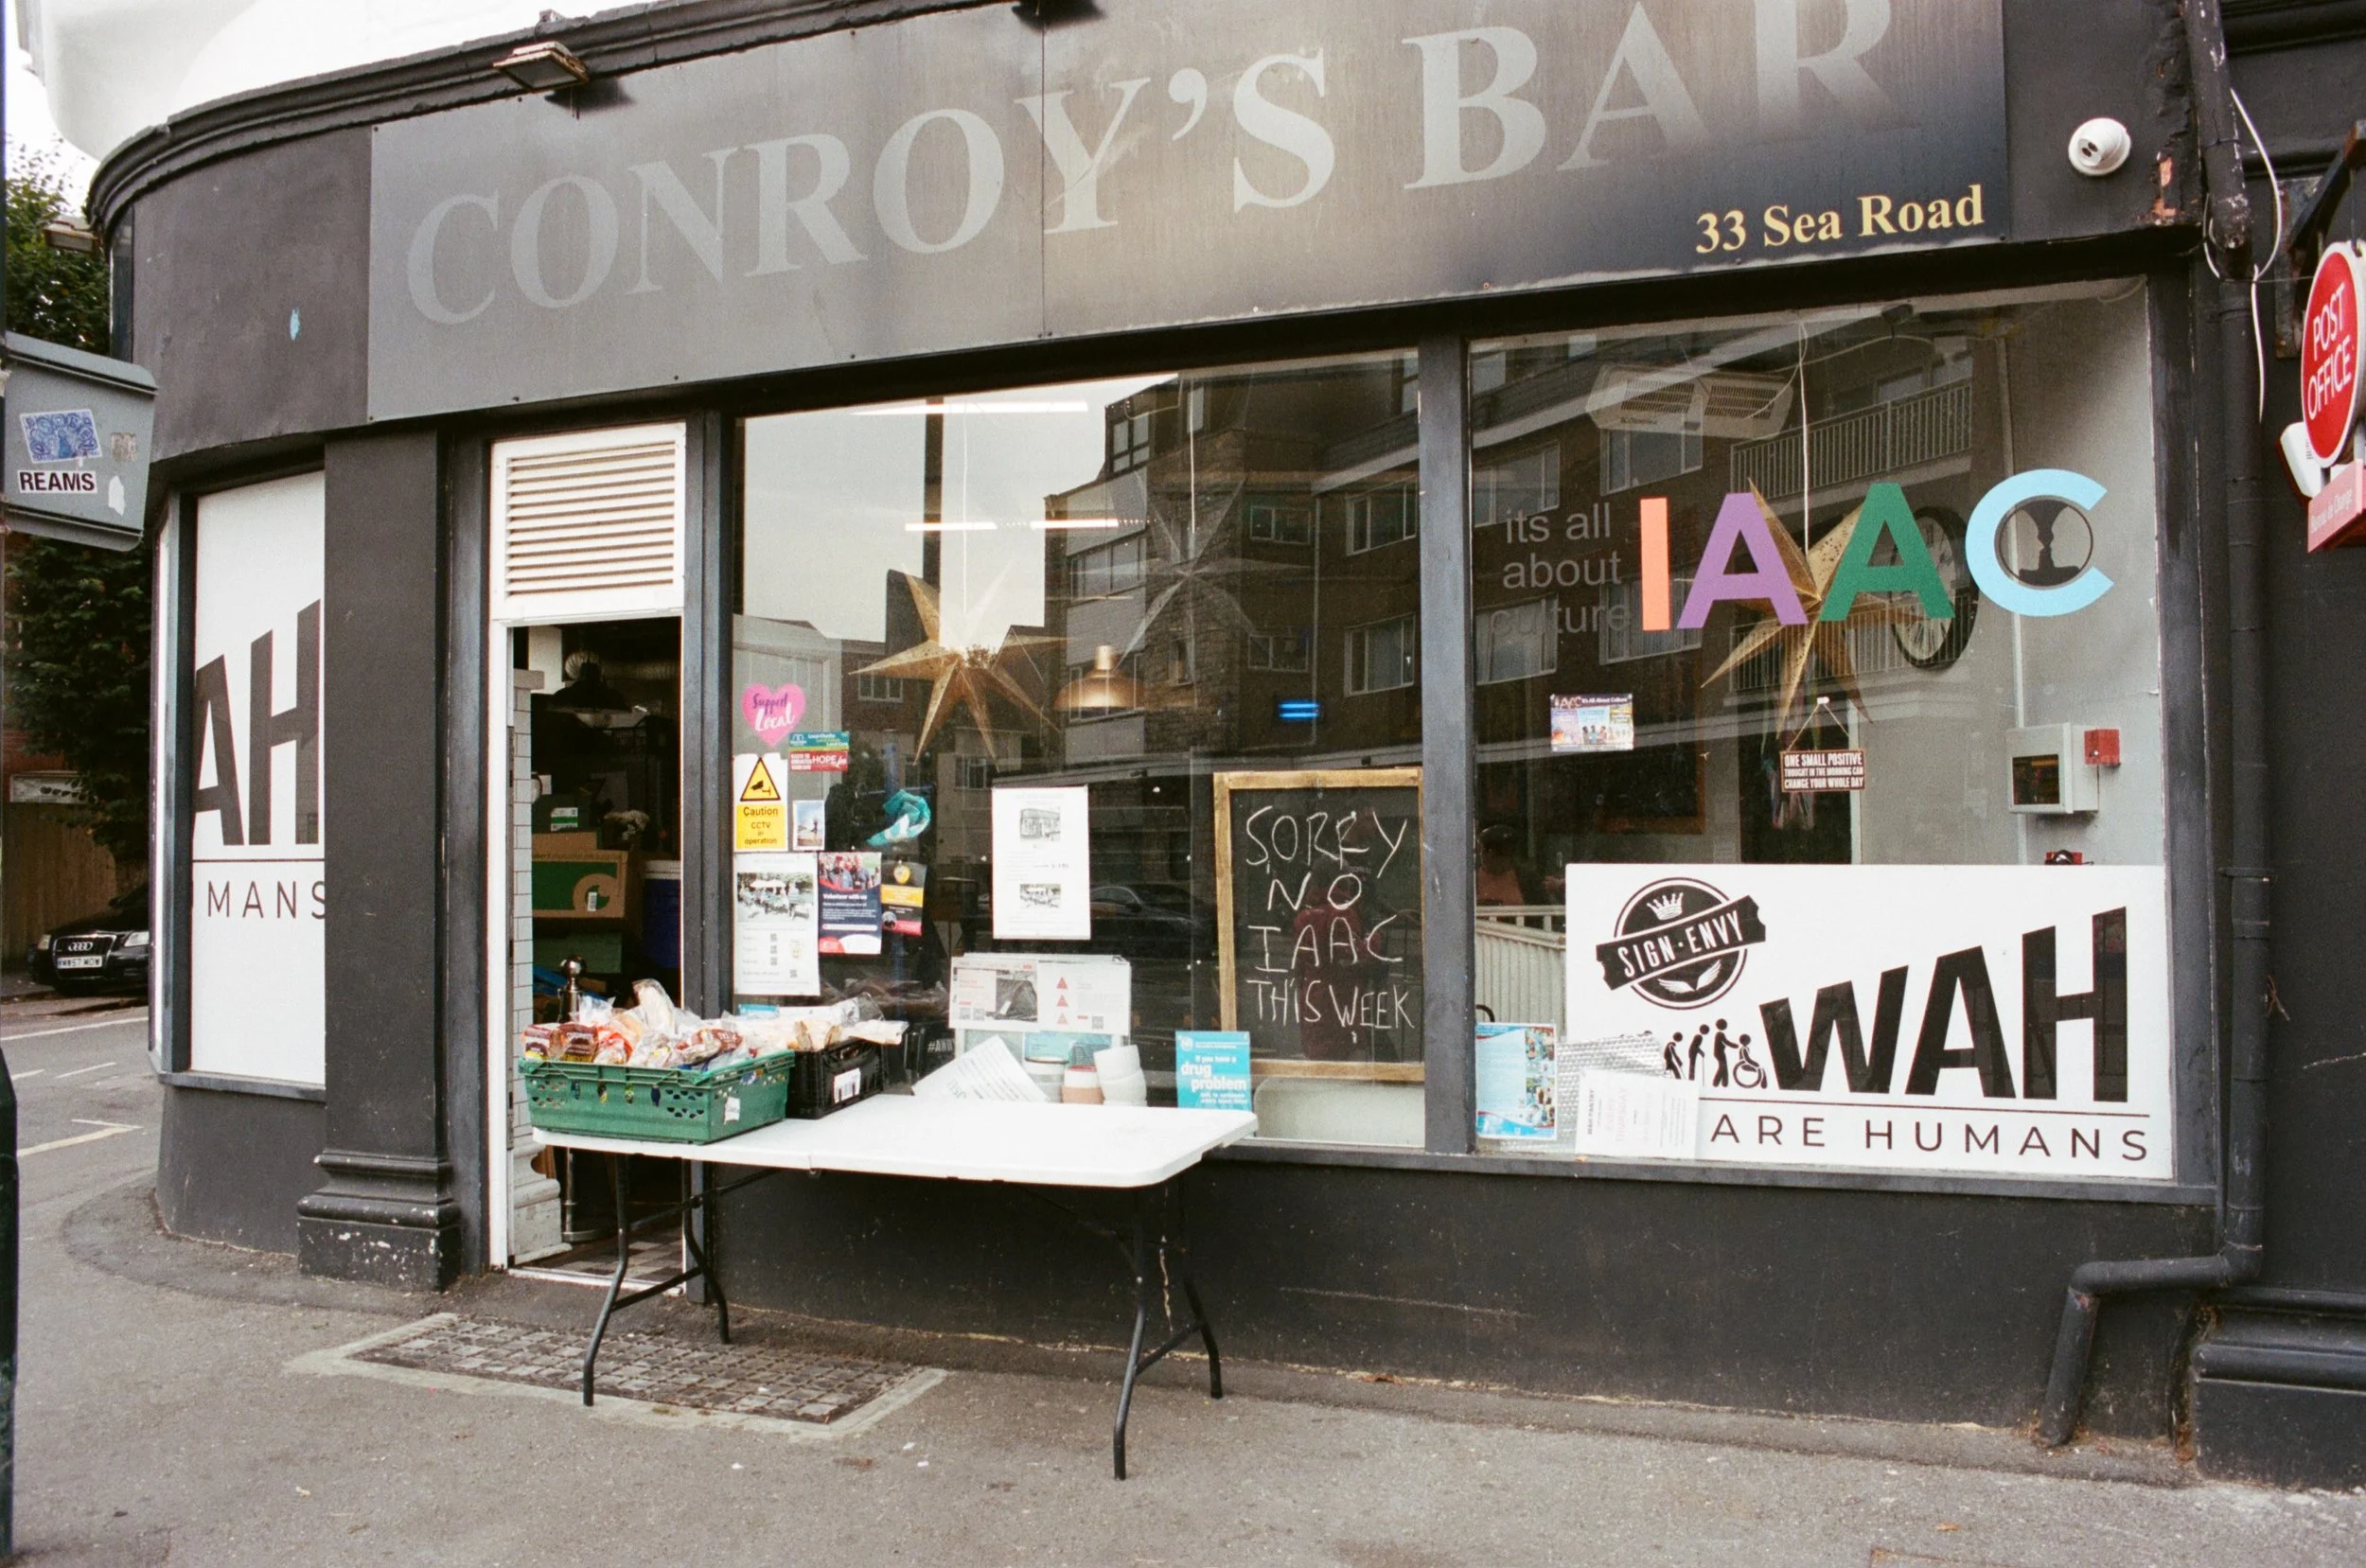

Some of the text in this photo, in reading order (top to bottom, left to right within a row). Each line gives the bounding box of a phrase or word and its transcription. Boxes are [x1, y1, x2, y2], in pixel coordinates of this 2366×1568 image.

[406, 0, 1923, 325] CONROY'S BAR
[1696, 184, 1985, 254] 33 Sea Road
[2307, 282, 2353, 421] POST OFFICE
[19, 472, 96, 491] REAMS
[1506, 502, 1611, 544] its all
[1639, 467, 2114, 632] IAAC
[1502, 551, 1621, 590] about
[752, 693, 788, 715] Support
[754, 701, 796, 731] Local
[1784, 752, 1863, 766] ONE SMALL POSITIVE
[1785, 776, 1863, 788] CHANGE YOUR WHOLE DAY
[743, 805, 778, 817] Caution
[1245, 806, 1408, 879] SORRY
[1267, 872, 1363, 911] NO
[1247, 915, 1404, 973] IAAC
[1245, 978, 1416, 1029] THIS WEEK
[1758, 906, 2128, 1103] WAH
[1180, 1060, 1211, 1078] drug
[1191, 1076, 1246, 1093] problem
[1711, 1114, 1826, 1148] ARE
[1865, 1119, 2148, 1161] HUMANS
